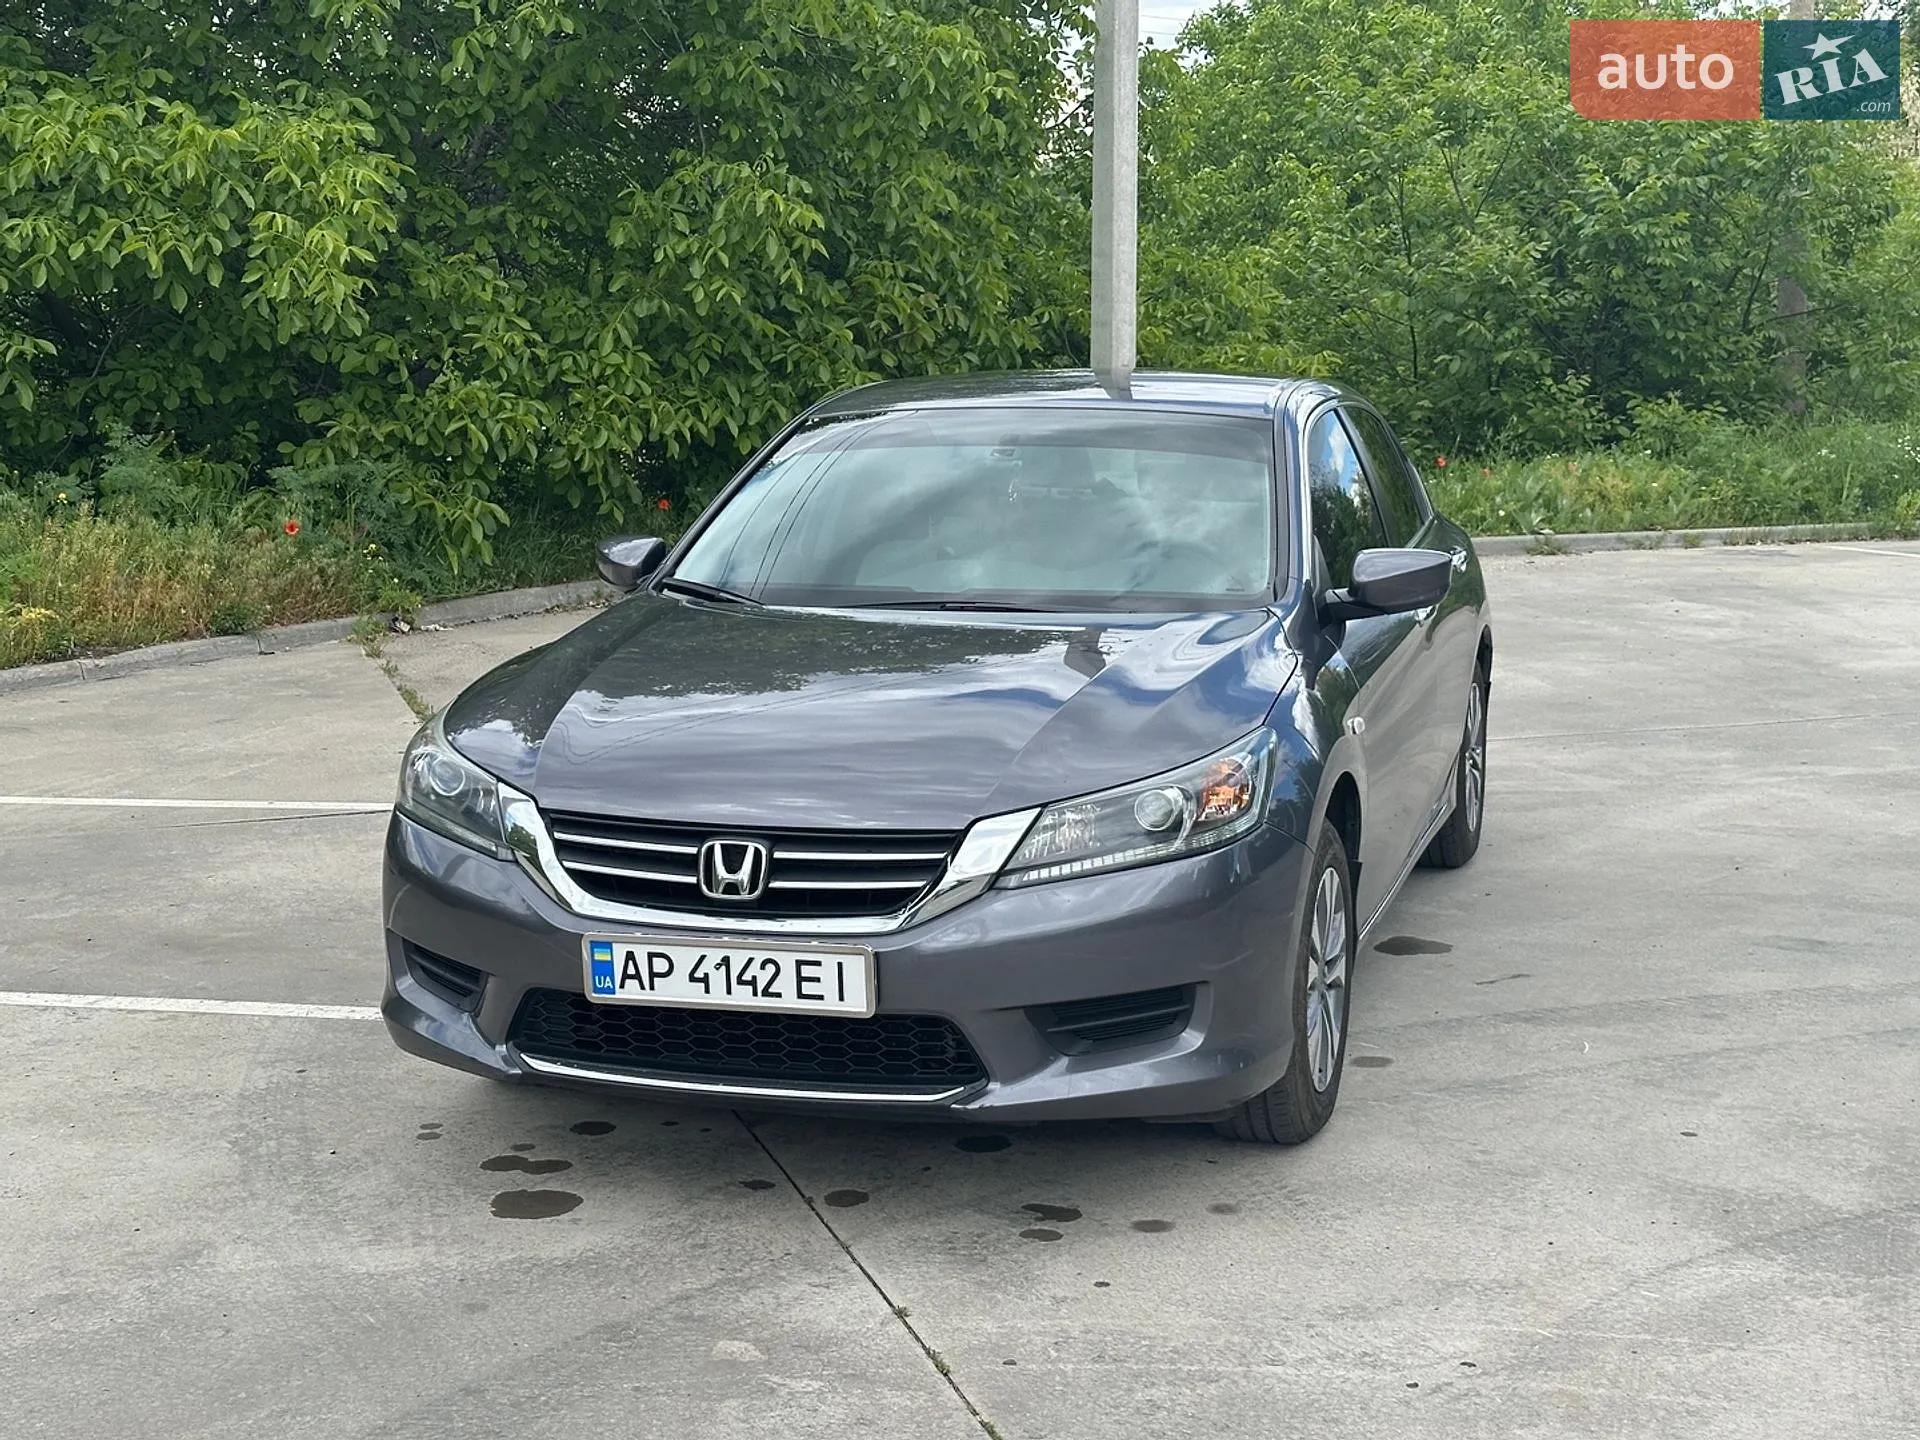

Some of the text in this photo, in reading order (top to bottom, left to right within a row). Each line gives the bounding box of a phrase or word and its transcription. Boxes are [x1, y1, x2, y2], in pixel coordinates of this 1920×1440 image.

[595, 974, 614, 990] UA
[619, 950, 675, 992] AP
[688, 954, 783, 999] 4142
